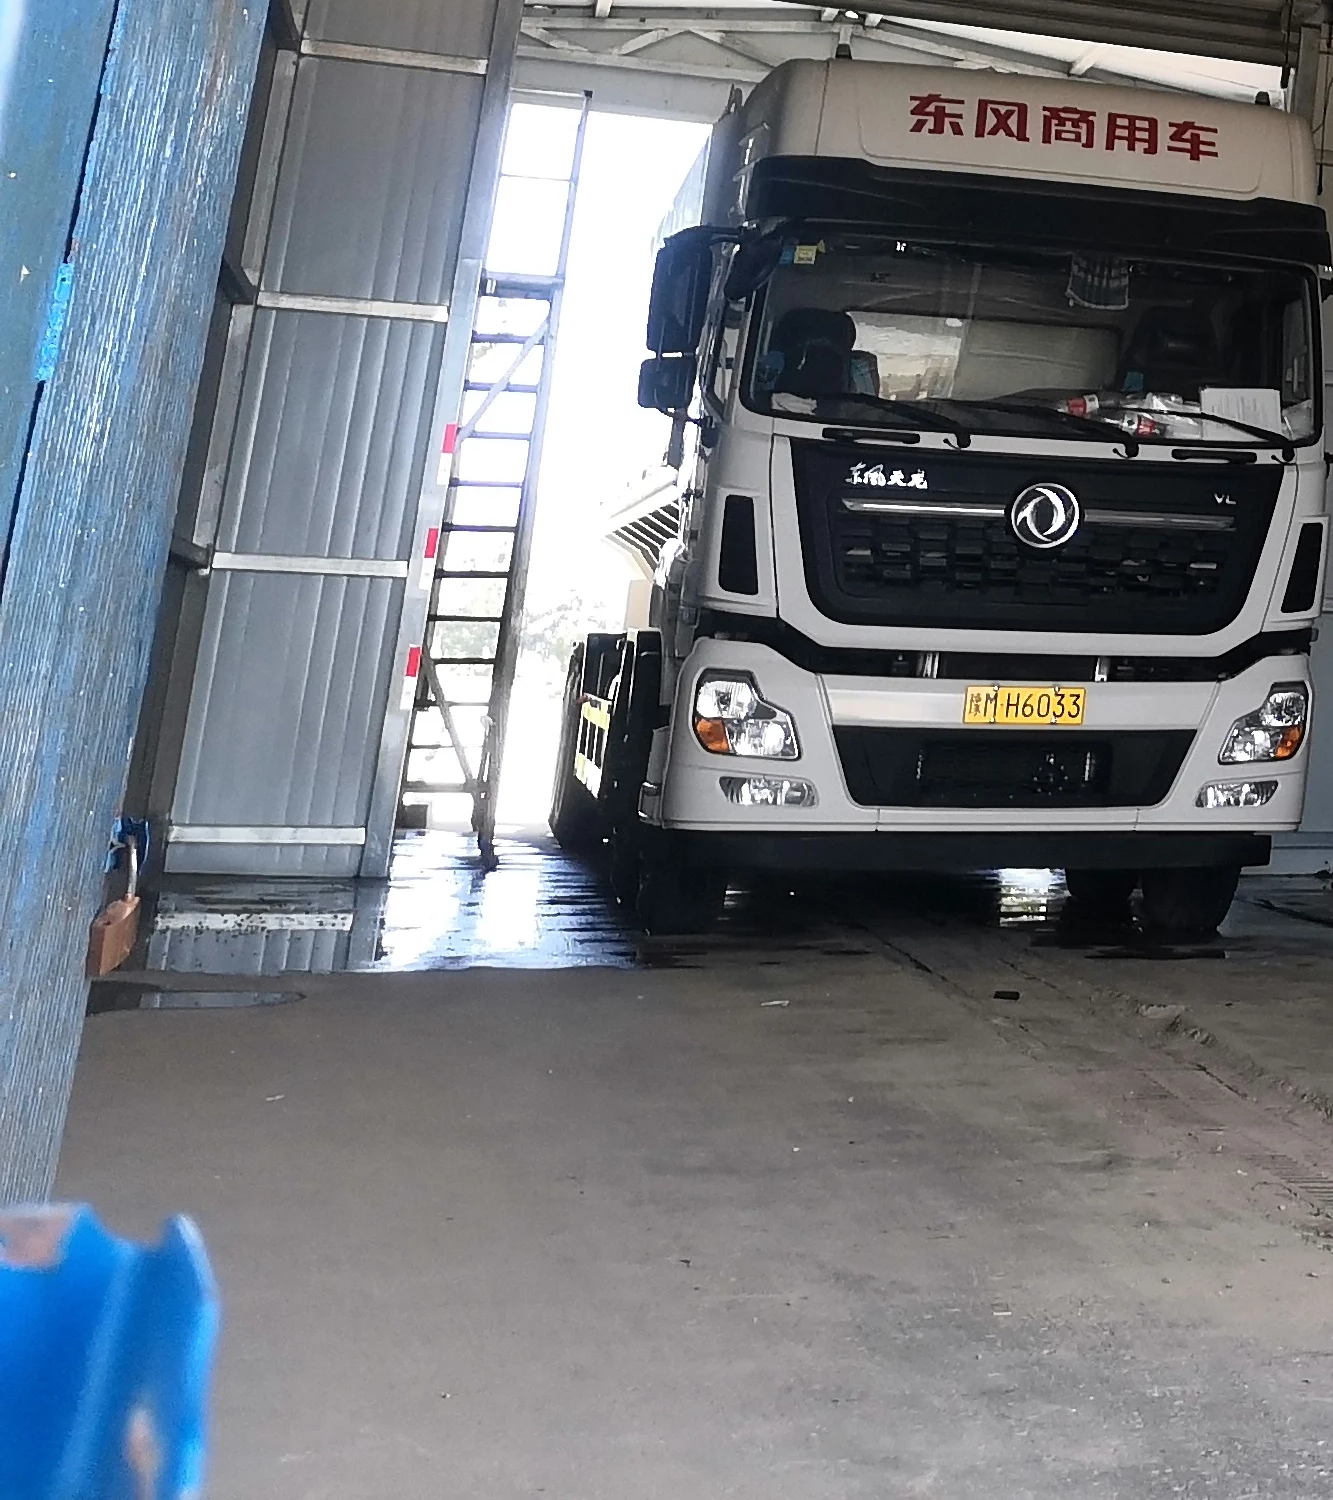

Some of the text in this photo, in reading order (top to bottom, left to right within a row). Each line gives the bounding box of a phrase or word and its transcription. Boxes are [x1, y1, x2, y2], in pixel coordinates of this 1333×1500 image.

[909, 94, 1218, 161] 东风商用车
